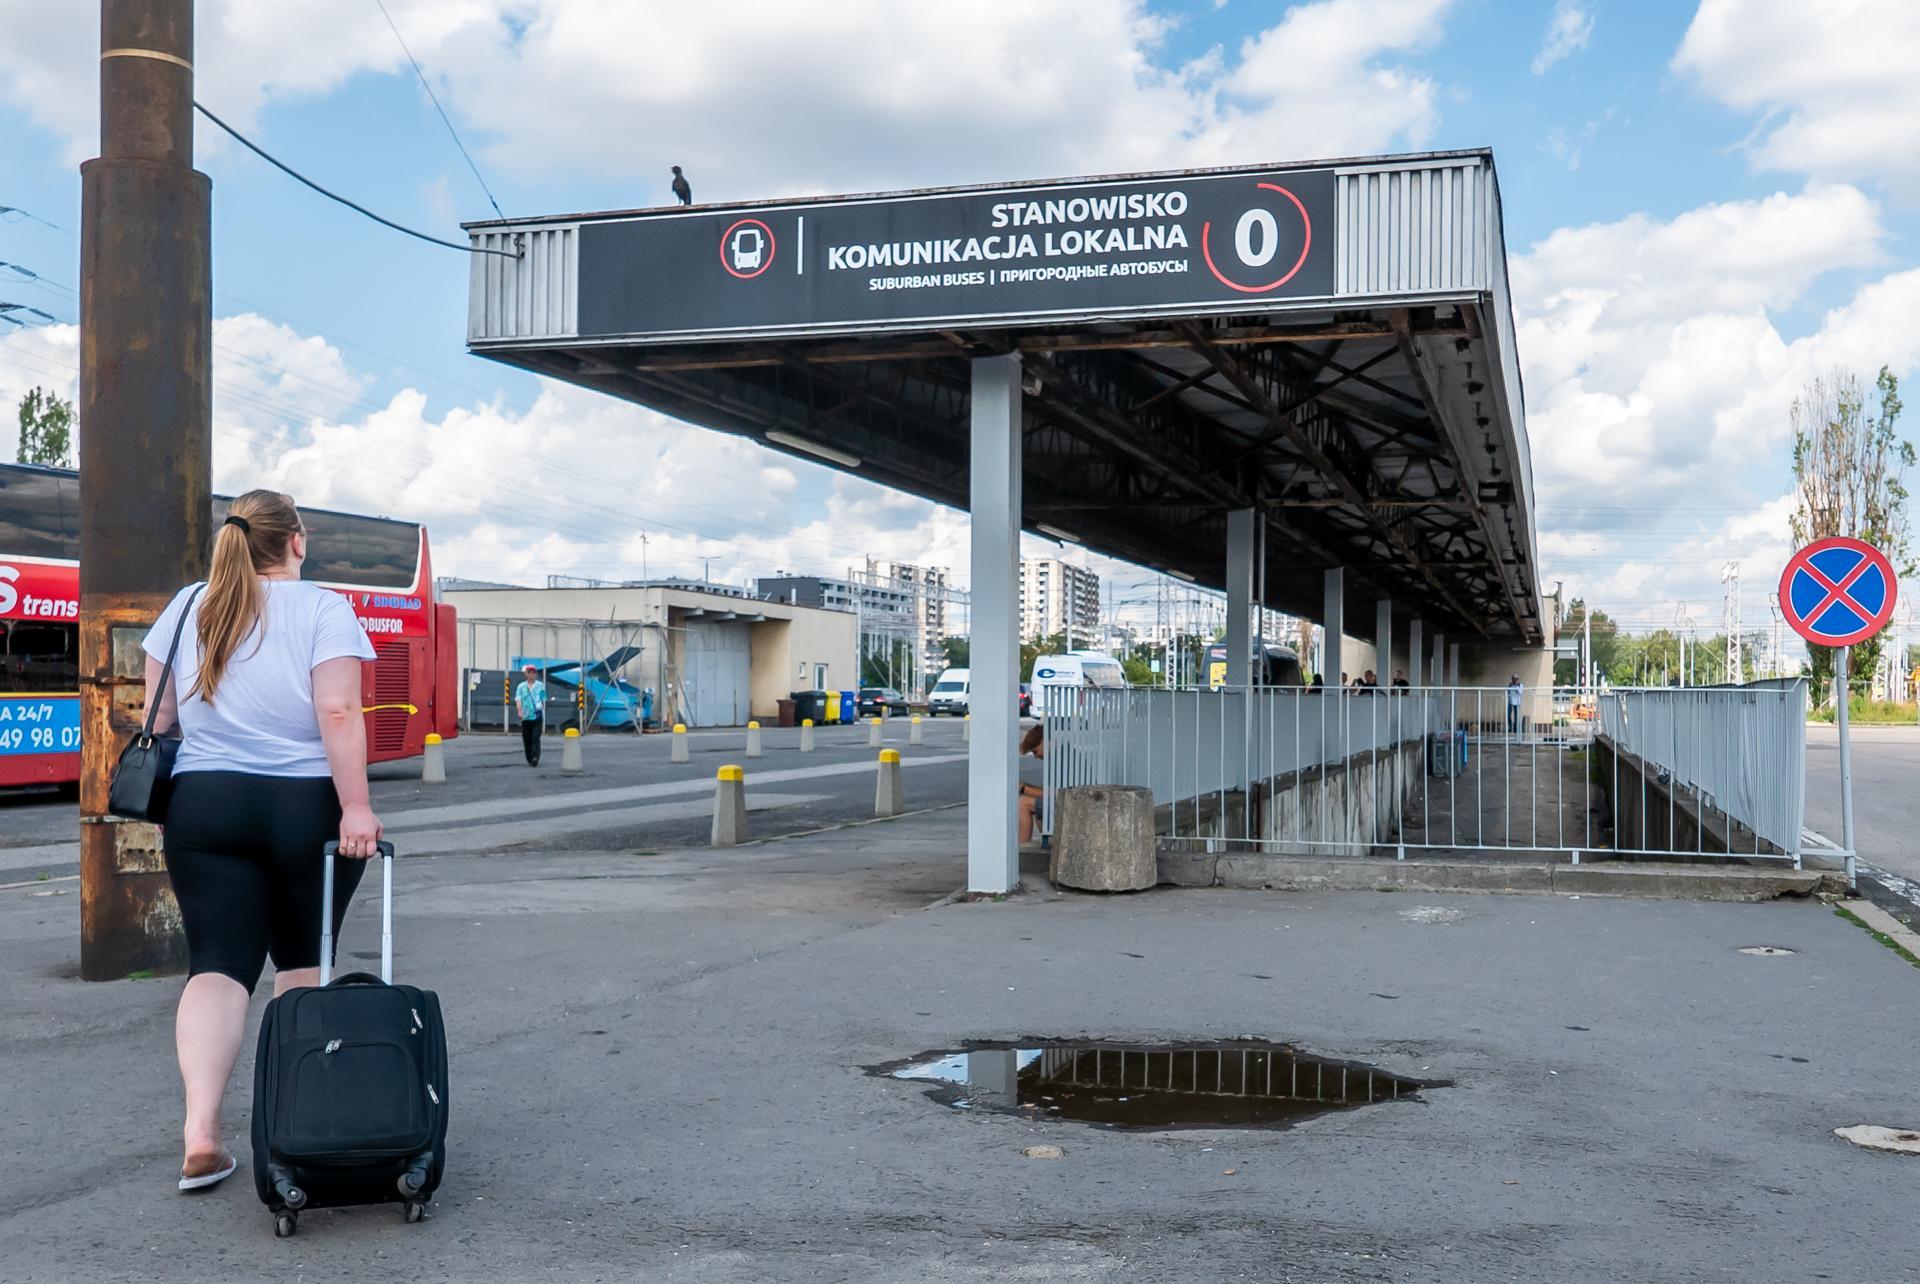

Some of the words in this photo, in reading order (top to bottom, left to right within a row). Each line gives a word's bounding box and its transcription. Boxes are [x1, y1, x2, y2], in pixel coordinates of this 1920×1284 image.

[991, 191, 1188, 228] STANOWISKO
[828, 234, 1038, 270] KOMUNIKACJA
[1045, 224, 1189, 256] LOKALNA
[1234, 208, 1278, 267] 0
[869, 274, 941, 291] SUBURBAN
[943, 271, 985, 287] BUSES
[1000, 264, 1109, 283] ПРИГОРОДНЫЕ
[1110, 259, 1188, 277] АВТОБУСЫ
[22, 594, 79, 617] trans
[368, 617, 403, 633] BUSFOR
[17, 703, 53, 722] 24/7
[30, 727, 54, 748] 98
[61, 726, 80, 747] 07
